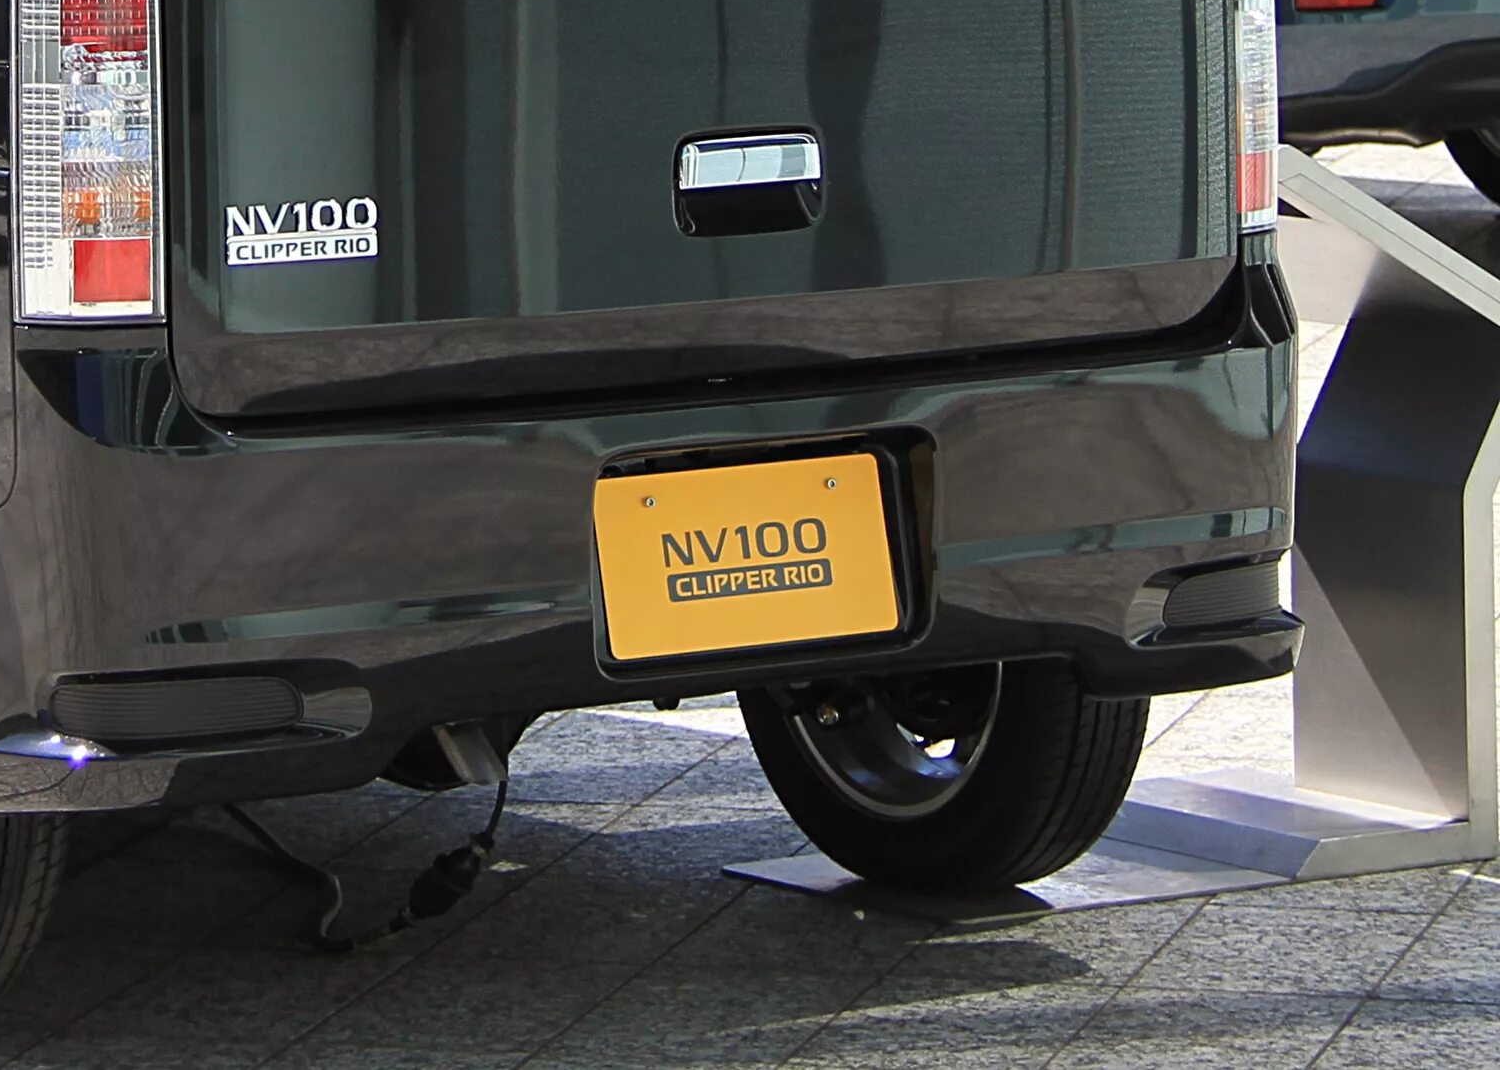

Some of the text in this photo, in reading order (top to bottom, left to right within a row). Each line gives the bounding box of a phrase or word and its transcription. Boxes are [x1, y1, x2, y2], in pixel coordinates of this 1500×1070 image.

[225, 197, 378, 236] NV100
[236, 237, 371, 261] CLIPPER RIO
[661, 517, 827, 568] NV100
[675, 563, 825, 598] CLIPPER RIO
